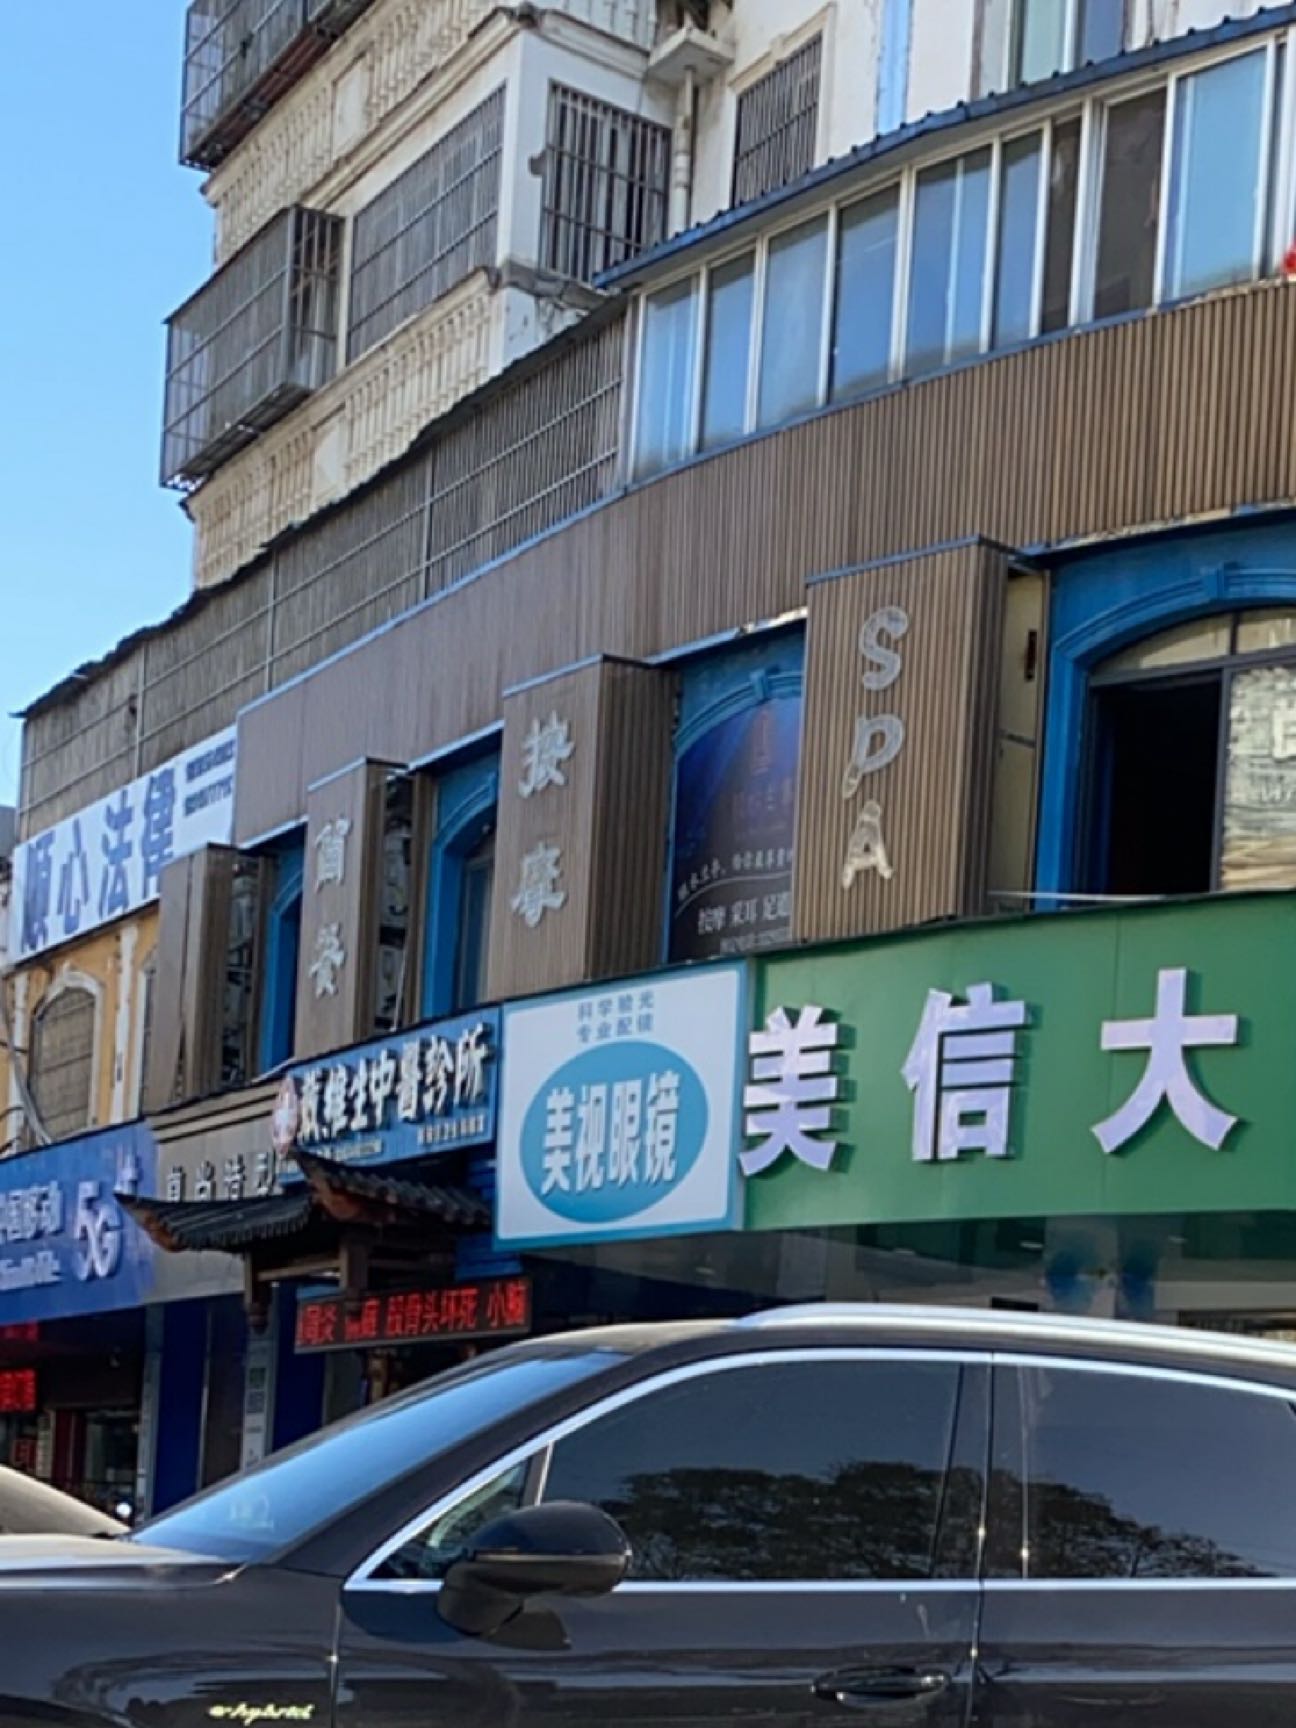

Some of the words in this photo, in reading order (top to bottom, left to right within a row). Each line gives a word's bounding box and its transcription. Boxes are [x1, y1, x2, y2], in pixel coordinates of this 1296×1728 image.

[841, 604, 911, 891] SPA
[540, 1069, 681, 1196] 美视眼镜
